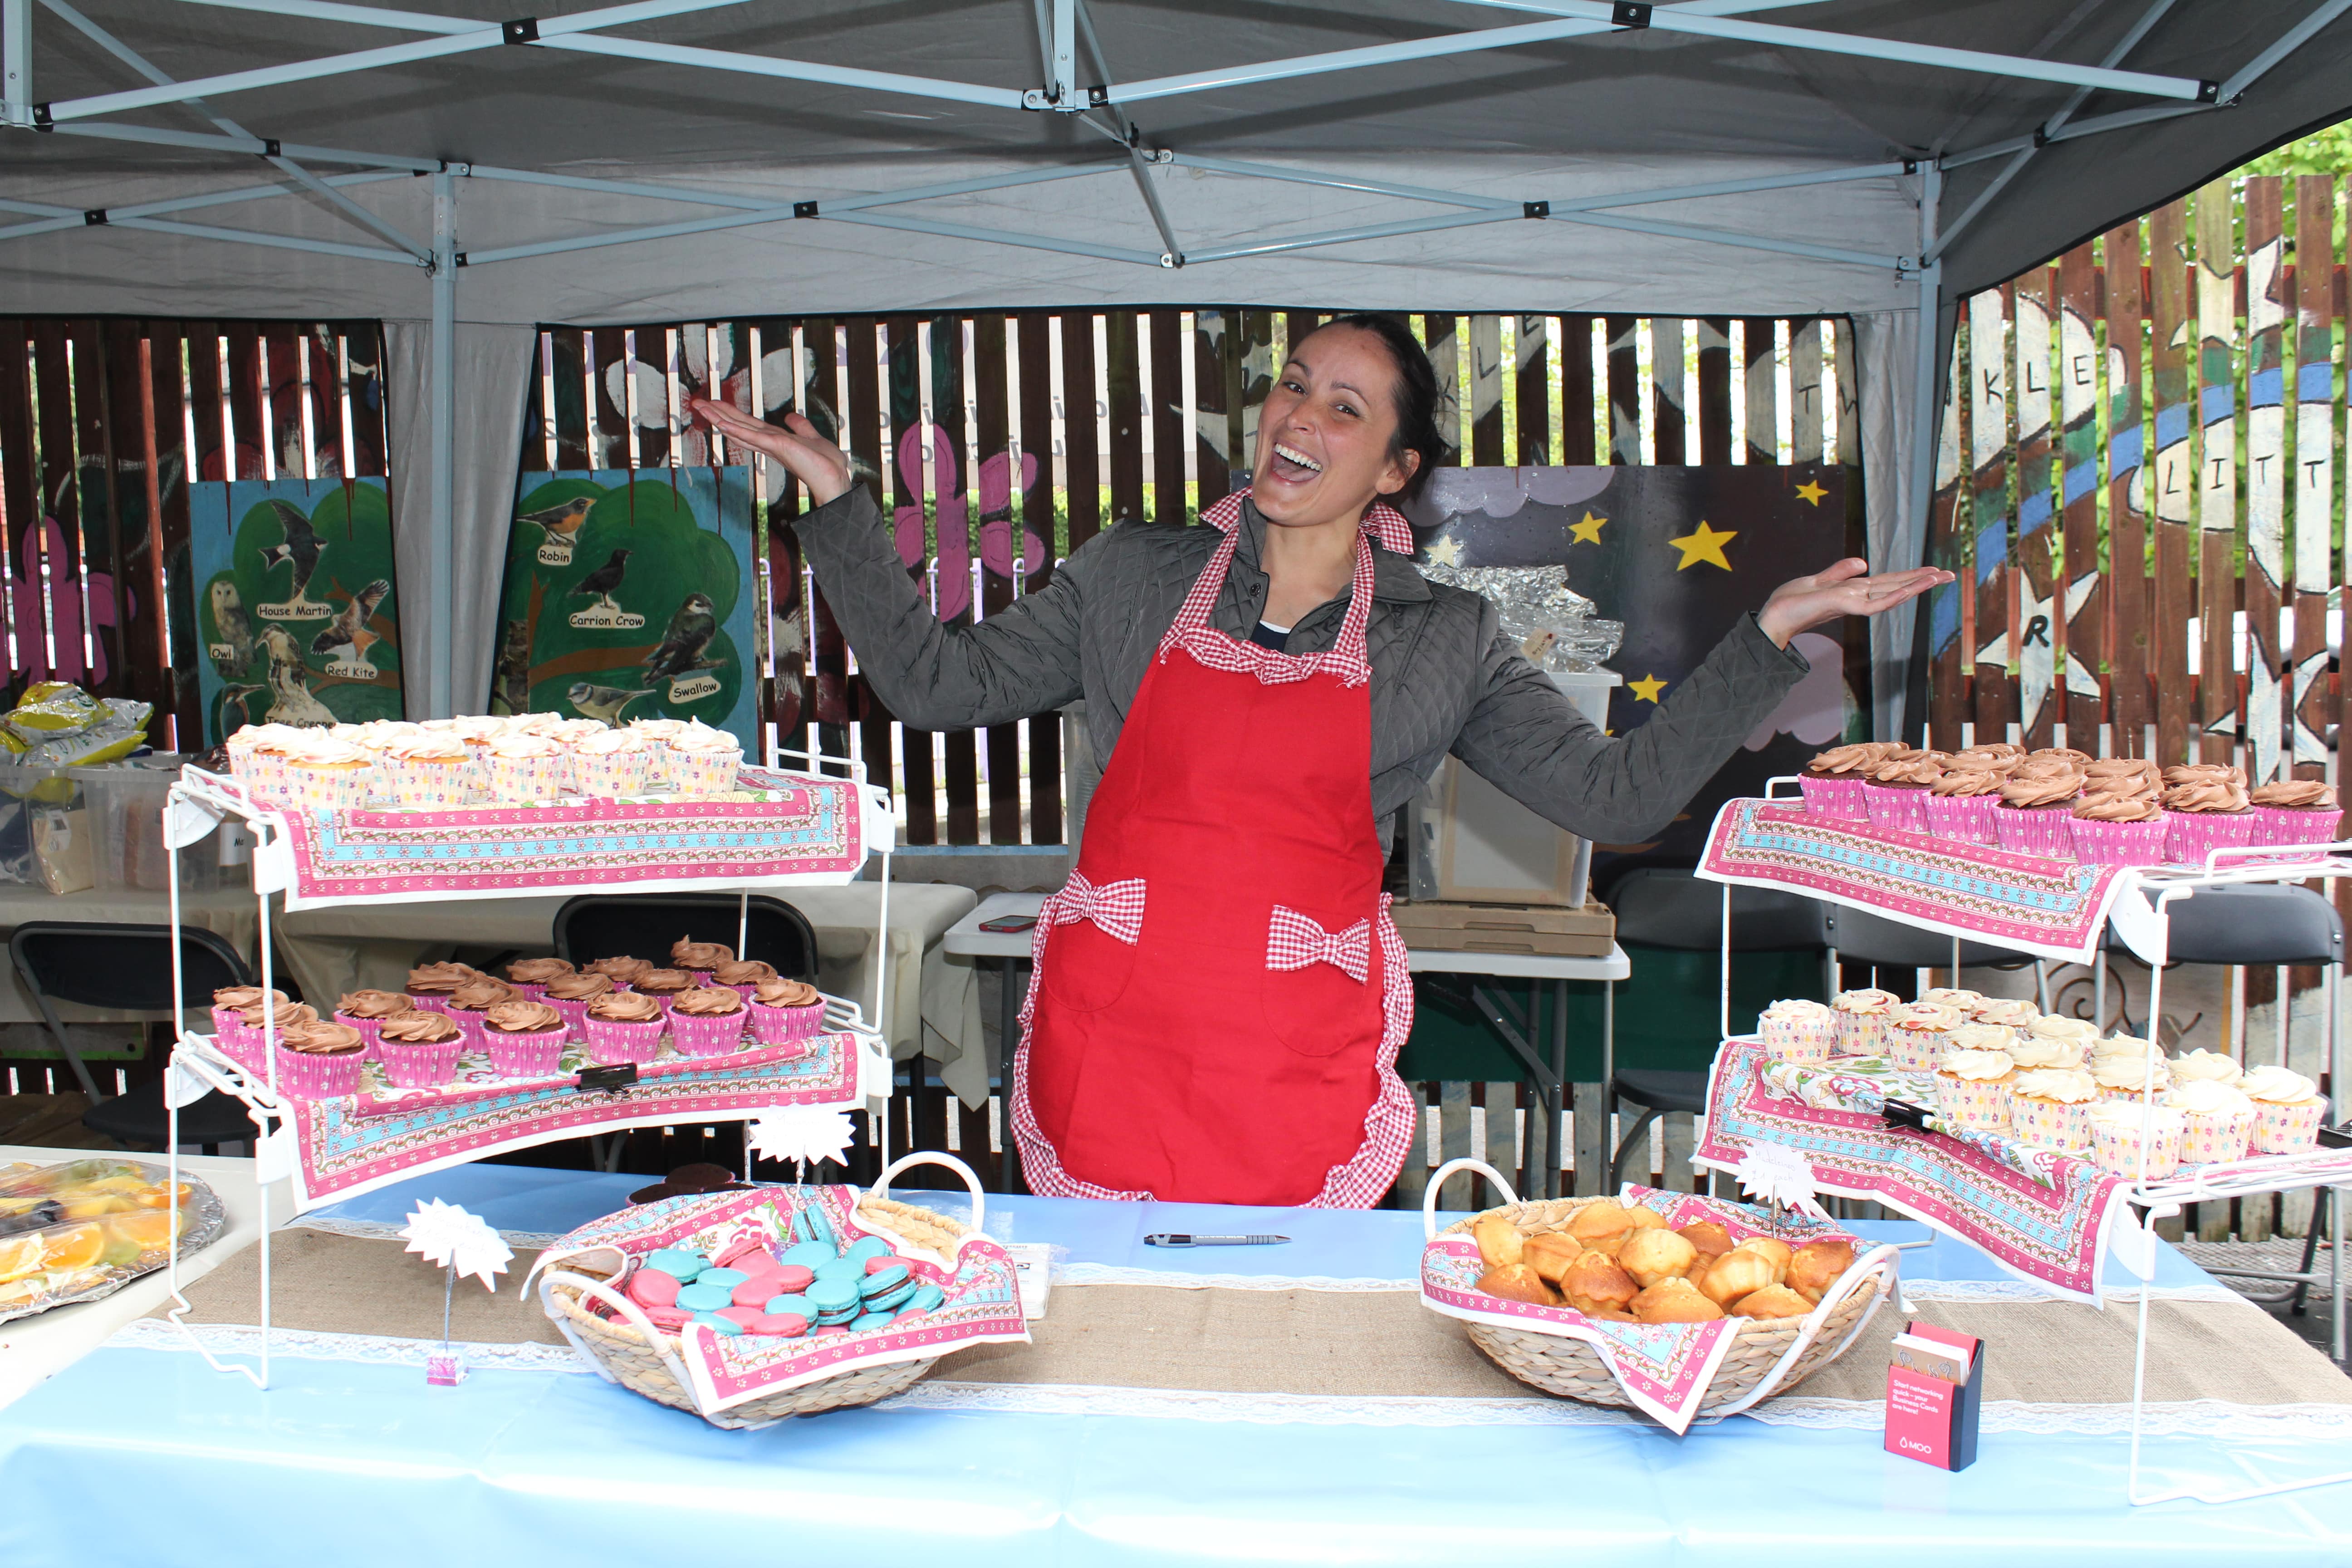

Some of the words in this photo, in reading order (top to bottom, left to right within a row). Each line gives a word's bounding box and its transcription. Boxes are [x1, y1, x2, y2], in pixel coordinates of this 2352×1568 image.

[539, 550, 569, 563] Robin
[259, 606, 291, 616] House
[296, 606, 332, 616] Martin
[570, 615, 611, 626] Carrion
[616, 616, 643, 626] Crow
[2023, 615, 2050, 647] R
[211, 648, 232, 660] Owl
[328, 666, 348, 677] Red
[353, 667, 376, 679] Kite
[673, 683, 717, 698] Swallow
[1774, 1171, 1794, 1183] each
[1892, 1388, 1910, 1397] quick
[1914, 1394, 1929, 1402] your
[1893, 1379, 1909, 1390] Start
[1909, 1385, 1944, 1401] networking
[1892, 1394, 1920, 1408] Business
[1920, 1402, 1939, 1413] Cards
[1902, 1405, 1919, 1415] here!
[1909, 1441, 1931, 1454] MOO
